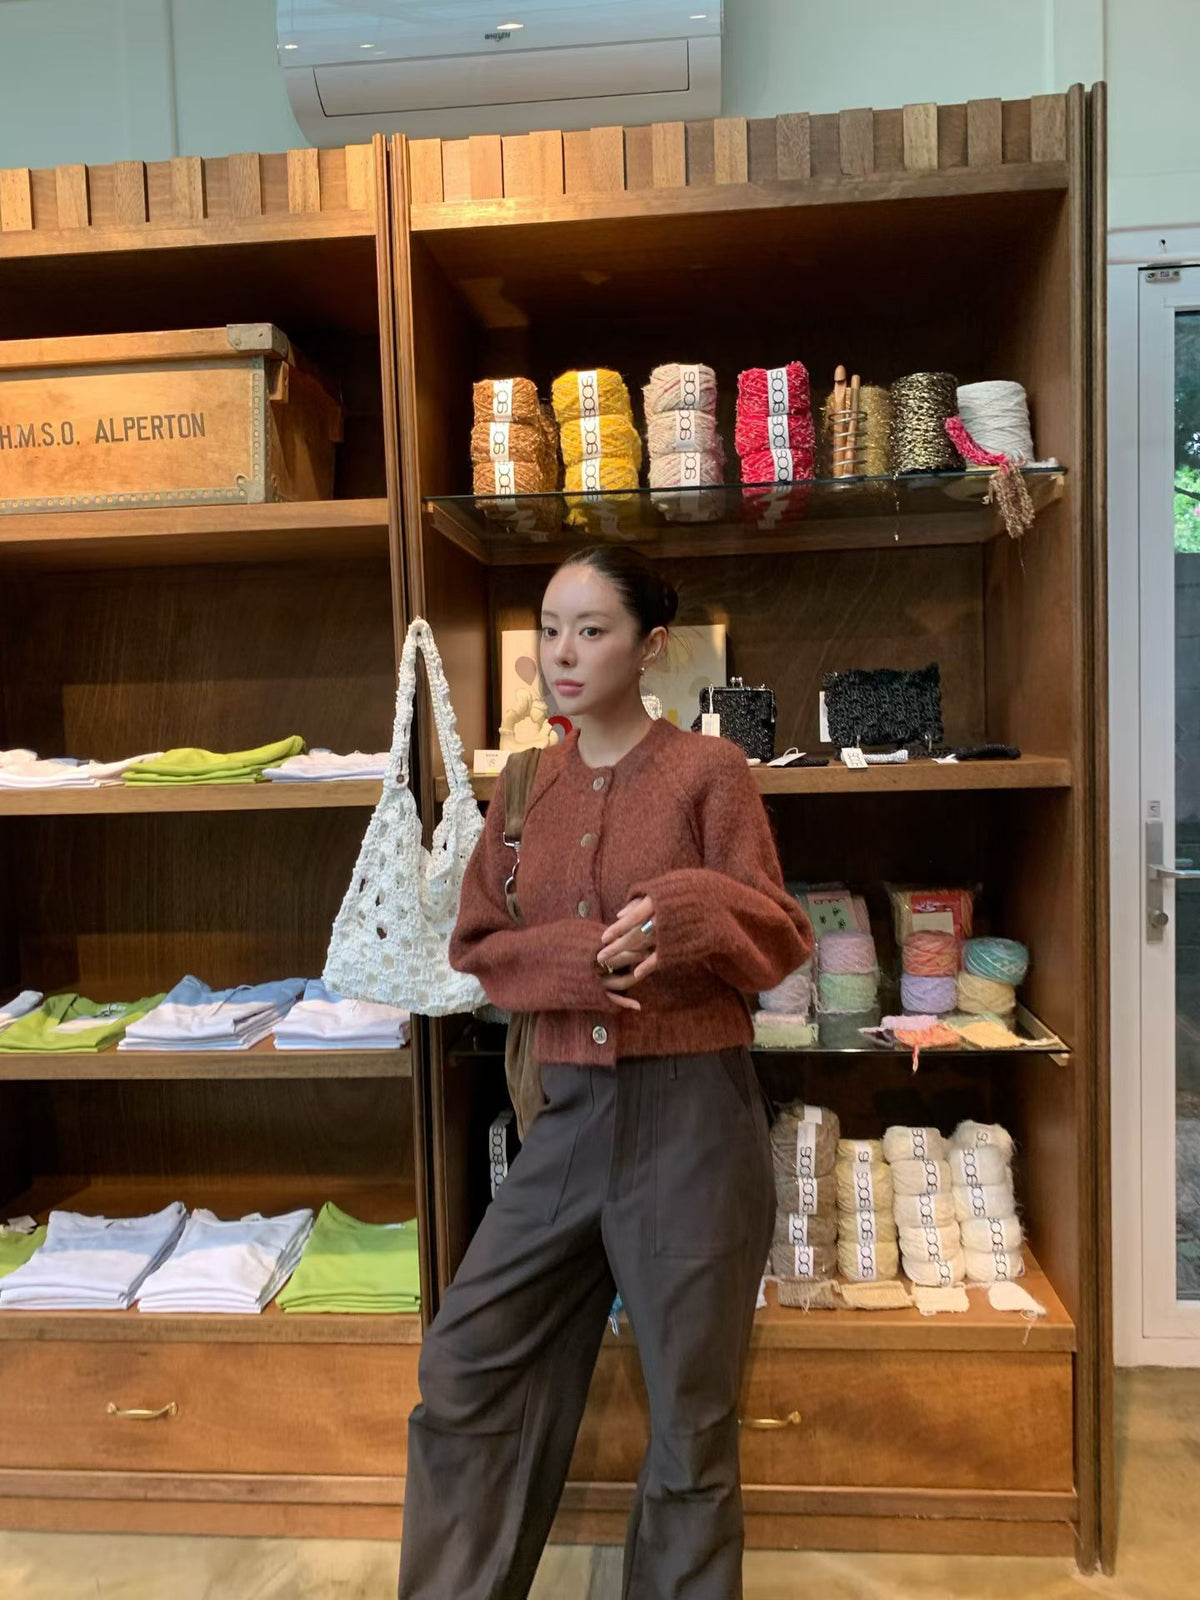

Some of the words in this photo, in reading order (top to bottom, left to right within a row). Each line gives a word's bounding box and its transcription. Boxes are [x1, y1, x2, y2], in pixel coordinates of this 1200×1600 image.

[0, 421, 80, 449] H.M.S.O.
[95, 412, 206, 443] ALPERTON
[679, 410, 692, 441] OOS
[771, 416, 786, 449] SOO
[800, 1146, 812, 1178] SOO
[919, 1193, 933, 1224] OOS
[860, 1210, 873, 1240] OOS
